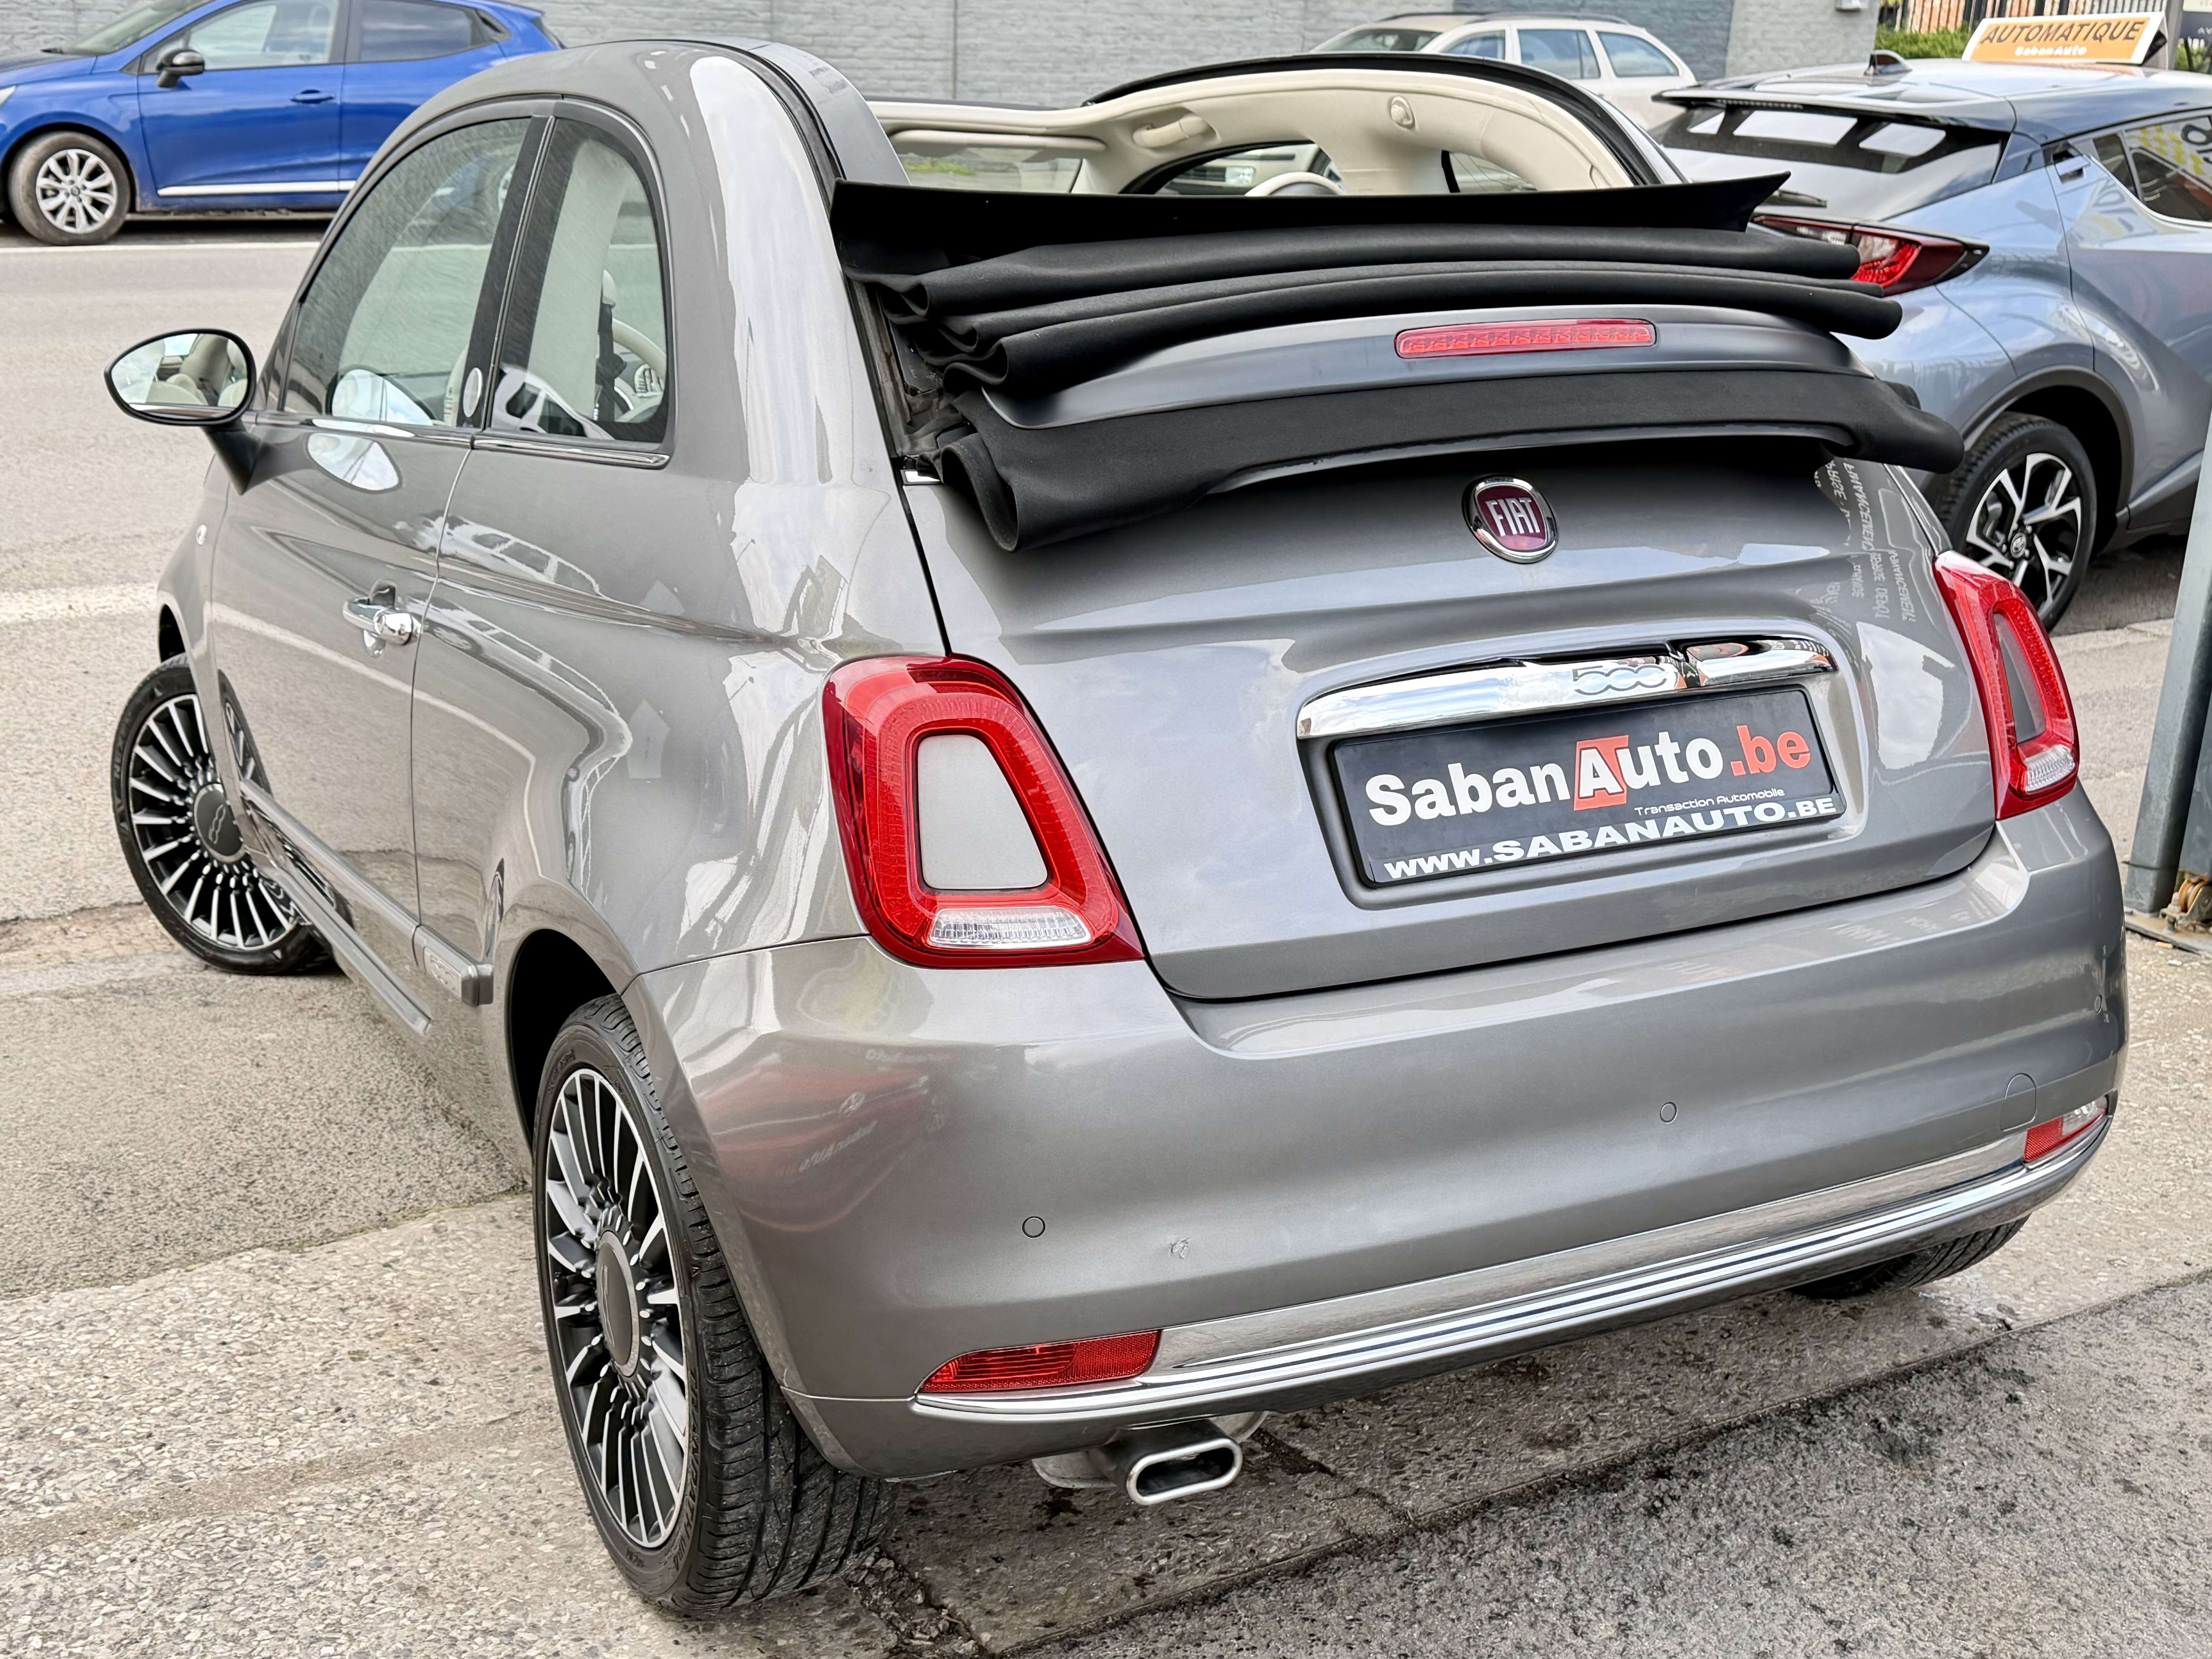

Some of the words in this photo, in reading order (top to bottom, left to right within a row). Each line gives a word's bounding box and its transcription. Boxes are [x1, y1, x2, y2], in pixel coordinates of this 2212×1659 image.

[1980, 21, 2145, 45] AUTOMATIQUE
[2015, 45, 2087, 57] SabanAuto
[1485, 497, 1540, 537] FIAT
[1572, 665, 1667, 696] 500
[1365, 725, 1811, 826] SabanAuto.be
[1634, 798, 1715, 816] Transaction
[1716, 788, 1785, 804] Automobile
